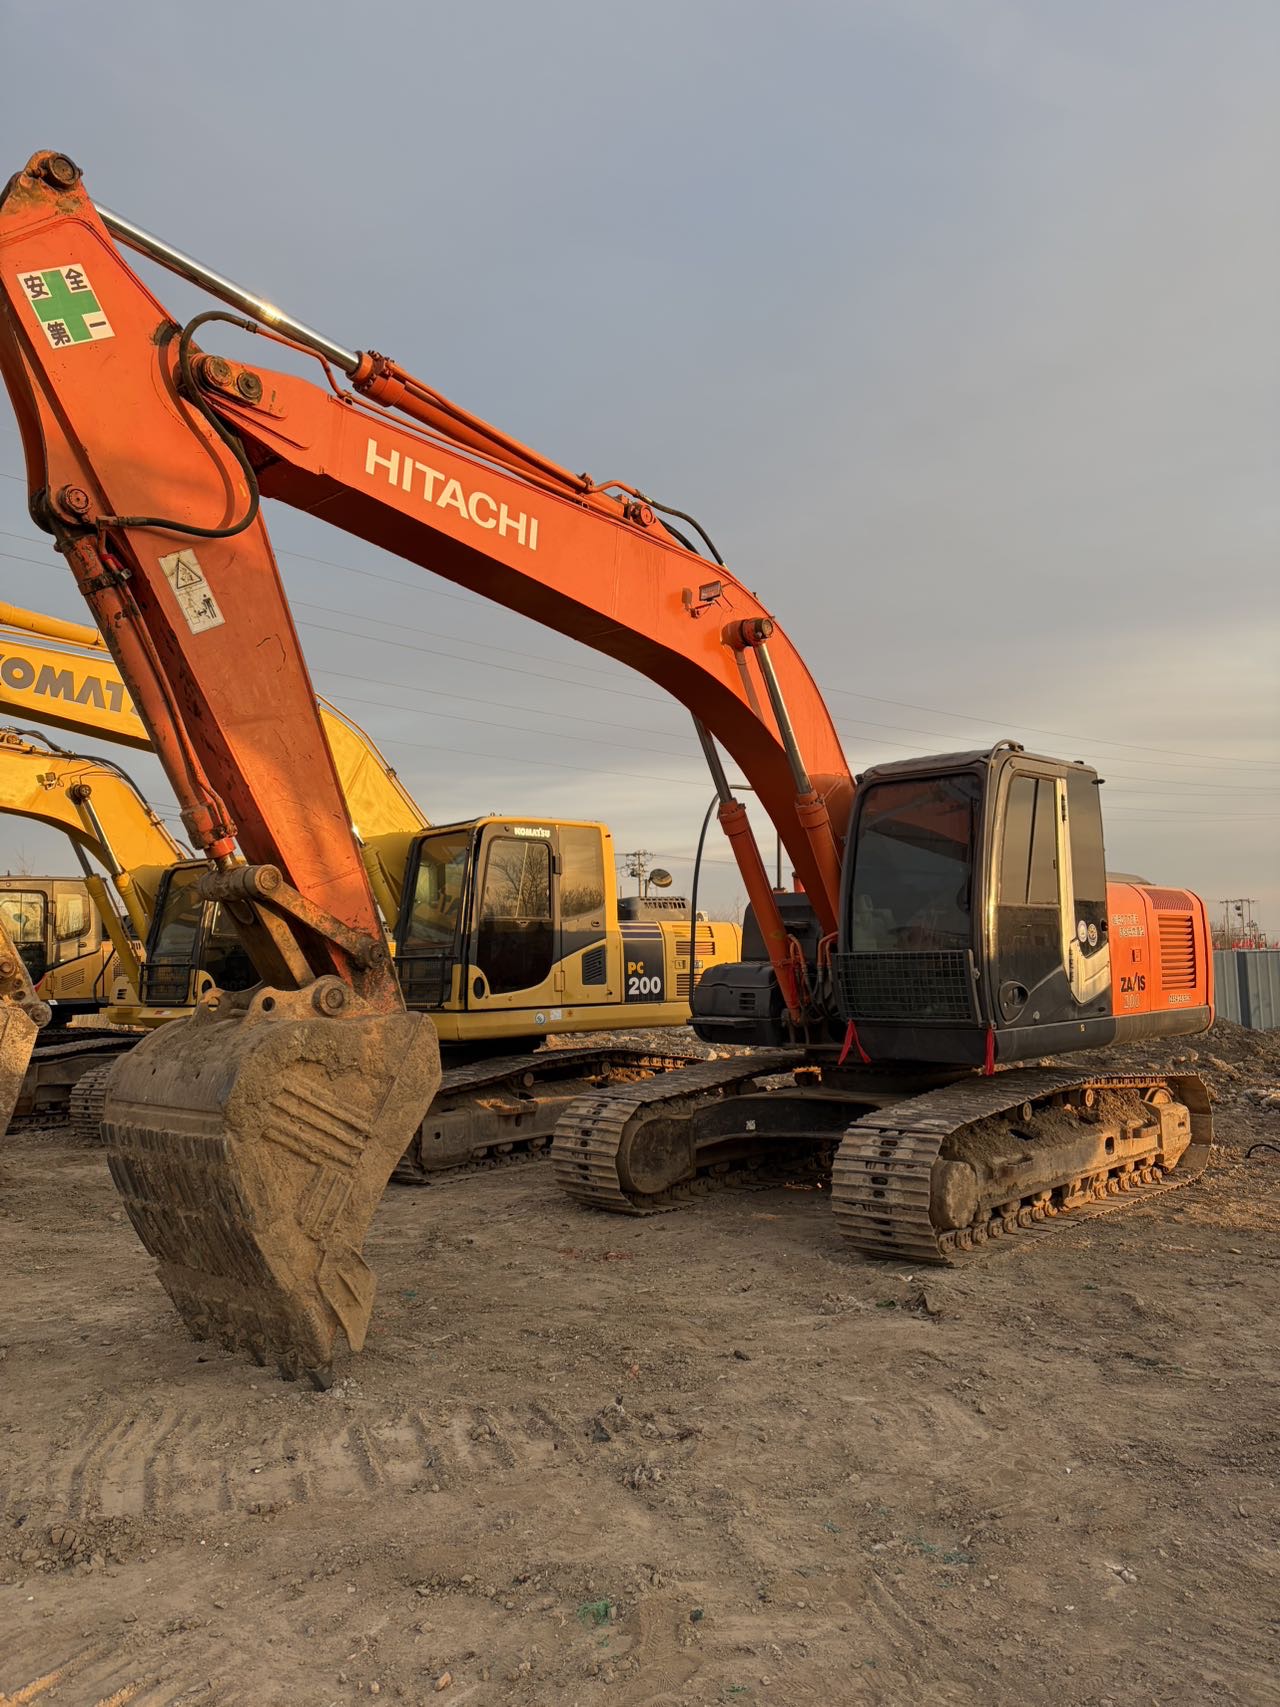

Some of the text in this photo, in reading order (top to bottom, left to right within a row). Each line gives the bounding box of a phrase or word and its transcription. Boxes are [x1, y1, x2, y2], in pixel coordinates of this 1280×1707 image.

[24, 267, 89, 299] 安全
[47, 320, 108, 347] 第一
[365, 438, 539, 551] HITACHI
[0, 654, 138, 716] OMAT
[514, 827, 551, 838] KOMATSU
[627, 961, 644, 975] PC
[628, 976, 662, 995] 200
